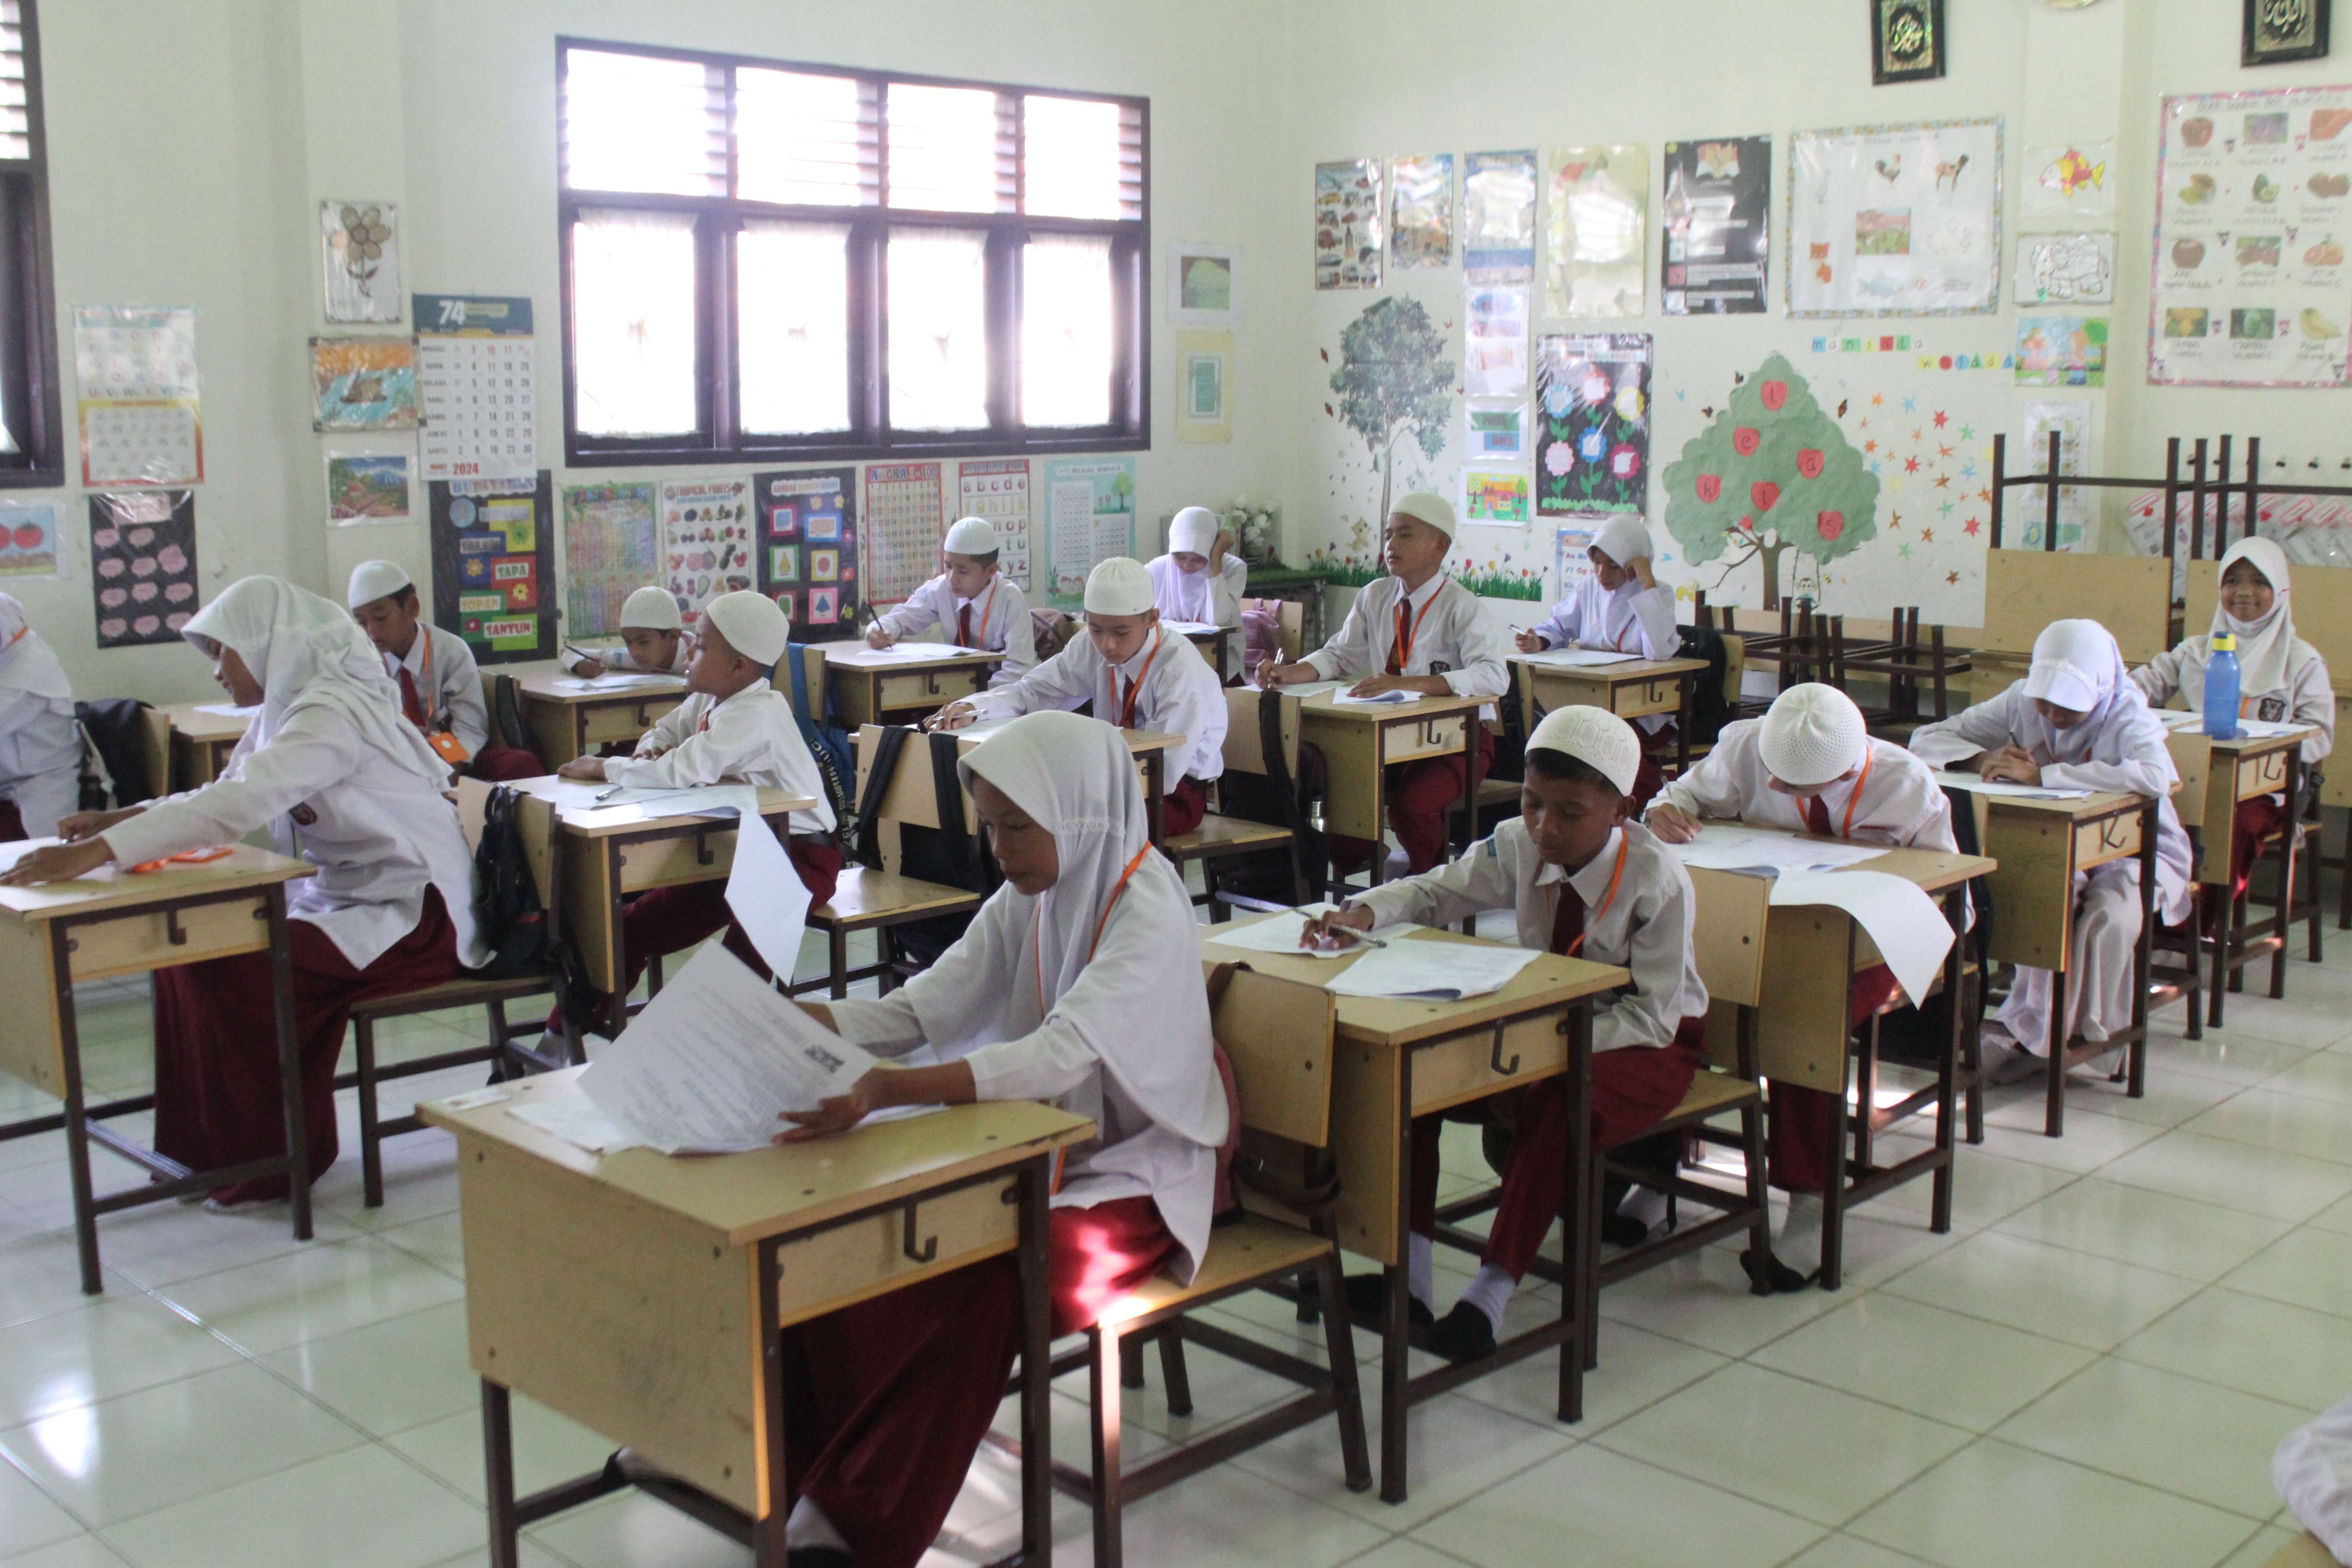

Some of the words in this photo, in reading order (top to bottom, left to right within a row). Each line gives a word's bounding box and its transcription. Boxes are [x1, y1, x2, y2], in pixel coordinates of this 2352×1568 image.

[439, 300, 465, 325] 74
[487, 345, 495, 354] 10
[471, 362, 476, 370] 4
[488, 362, 495, 371] 11
[505, 362, 512, 371] 18
[521, 362, 529, 371] 25
[472, 378, 476, 387] 5
[489, 378, 496, 387] 12
[505, 378, 513, 387] 19
[521, 378, 529, 387] 26
[489, 395, 496, 404] 13
[505, 395, 513, 404] 20
[522, 395, 530, 404] 27
[474, 412, 478, 421] 7
[489, 412, 497, 421] 14
[505, 412, 514, 421] 21
[522, 412, 530, 421] 28
[490, 429, 497, 438] 15
[506, 429, 514, 437] 22
[523, 429, 531, 437] 29
[459, 446, 462, 455] 2
[475, 446, 480, 455] 9
[491, 446, 498, 454] 16
[507, 445, 515, 454] 23
[523, 445, 531, 454] 30
[453, 462, 479, 475] 2024
[871, 467, 907, 481] ANGKA
[676, 485, 706, 496] TROPICAL
[708, 483, 731, 494] FRUITS
[964, 481, 971, 493] a
[977, 477, 985, 492] b
[991, 480, 999, 491] c
[1004, 476, 1012, 490] d
[1018, 478, 1025, 490] e
[965, 500, 970, 514] f
[976, 500, 985, 514] g
[990, 498, 998, 513] h
[1009, 496, 1014, 515] j
[1018, 496, 1025, 511] k
[994, 521, 1002, 532] n
[1006, 521, 1015, 531] o
[1019, 519, 1027, 534] p
[1006, 537, 1011, 551] t
[1018, 539, 1026, 549] u
[498, 565, 526, 578] SAPA
[1007, 561, 1014, 575] y
[1019, 560, 1026, 570] z
[486, 622, 531, 635] SANTUN
